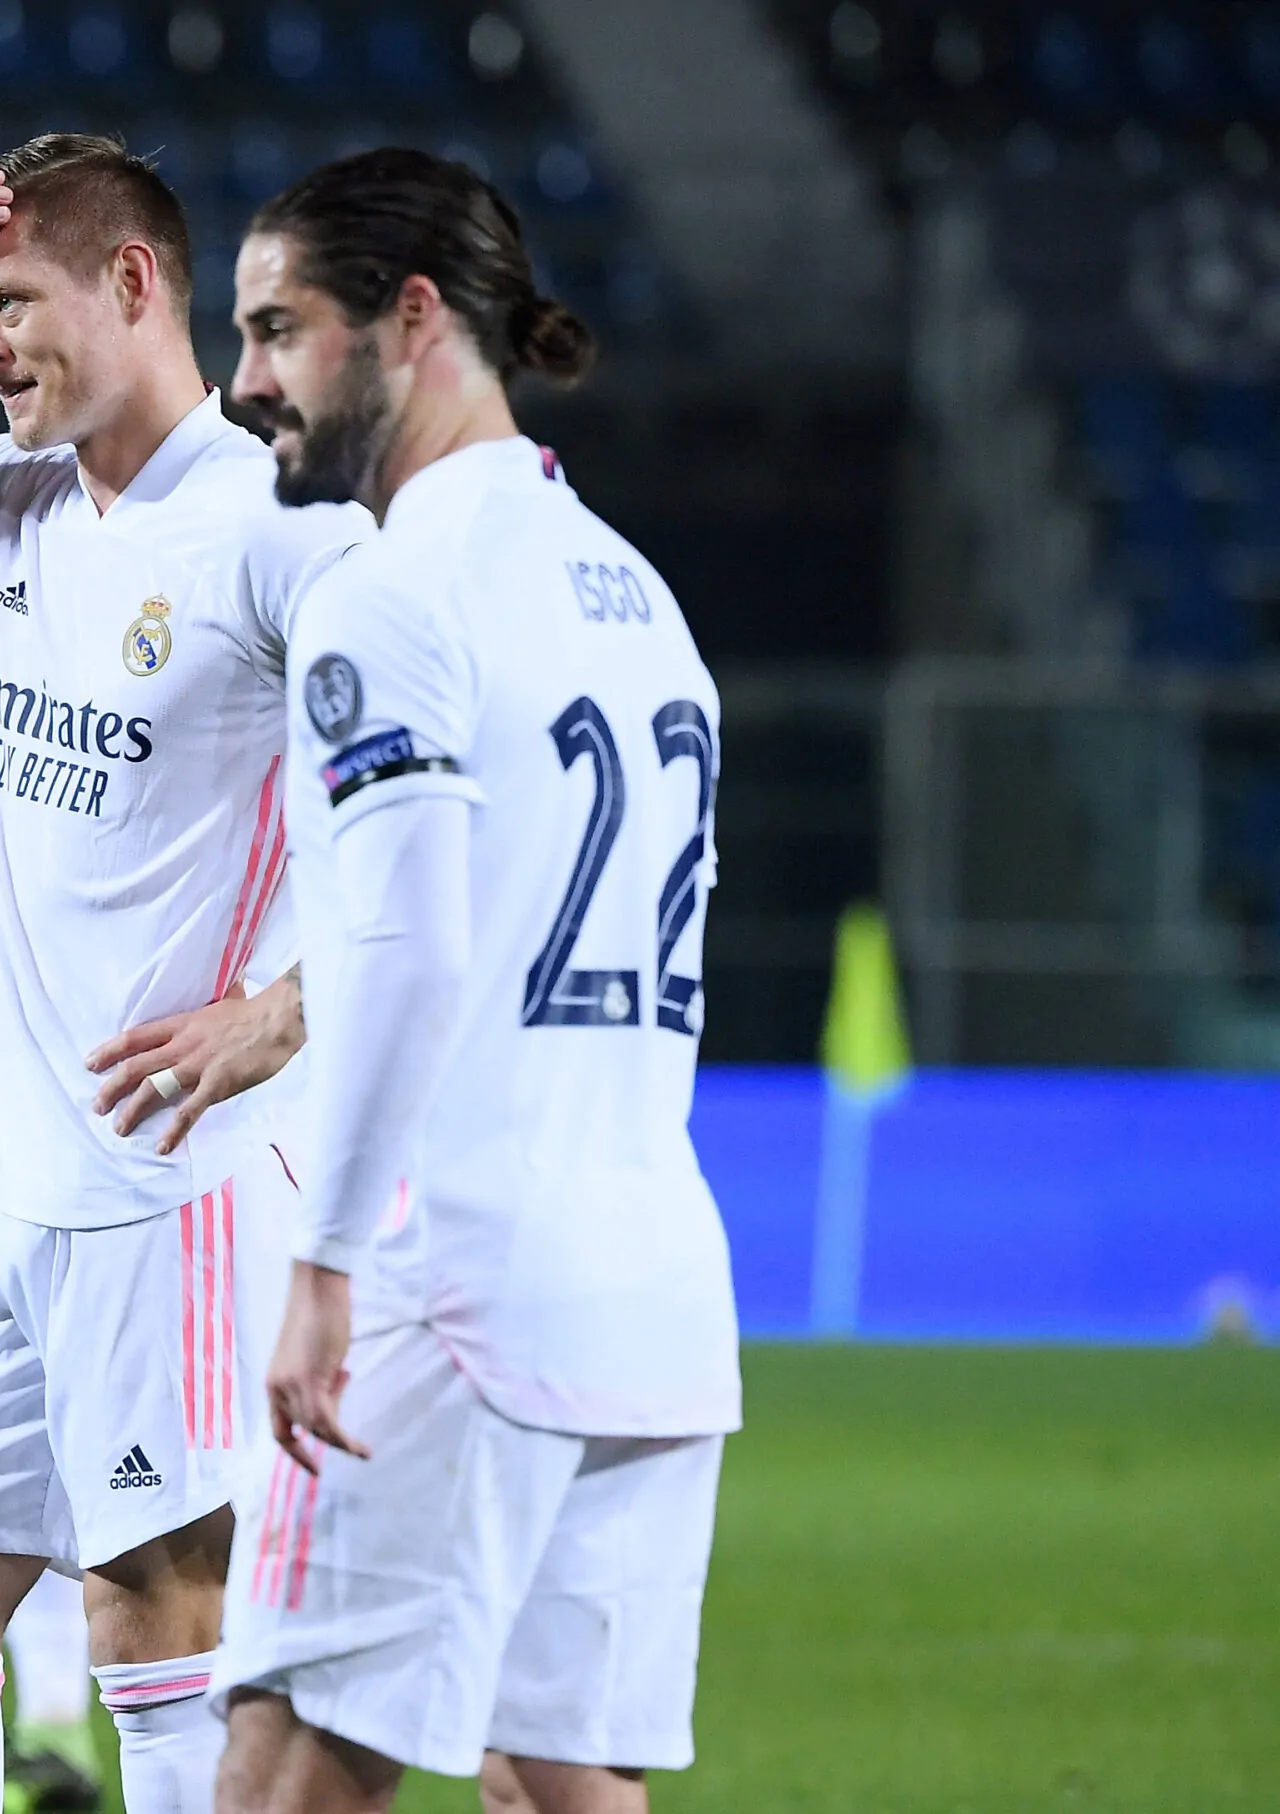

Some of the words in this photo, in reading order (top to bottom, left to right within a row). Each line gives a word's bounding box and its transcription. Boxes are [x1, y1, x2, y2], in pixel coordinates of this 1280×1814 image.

[563, 560, 651, 625] ISCO
[16, 752, 109, 818] BETTER
[522, 696, 712, 1036] 22
[109, 1471, 163, 1490] adidas
